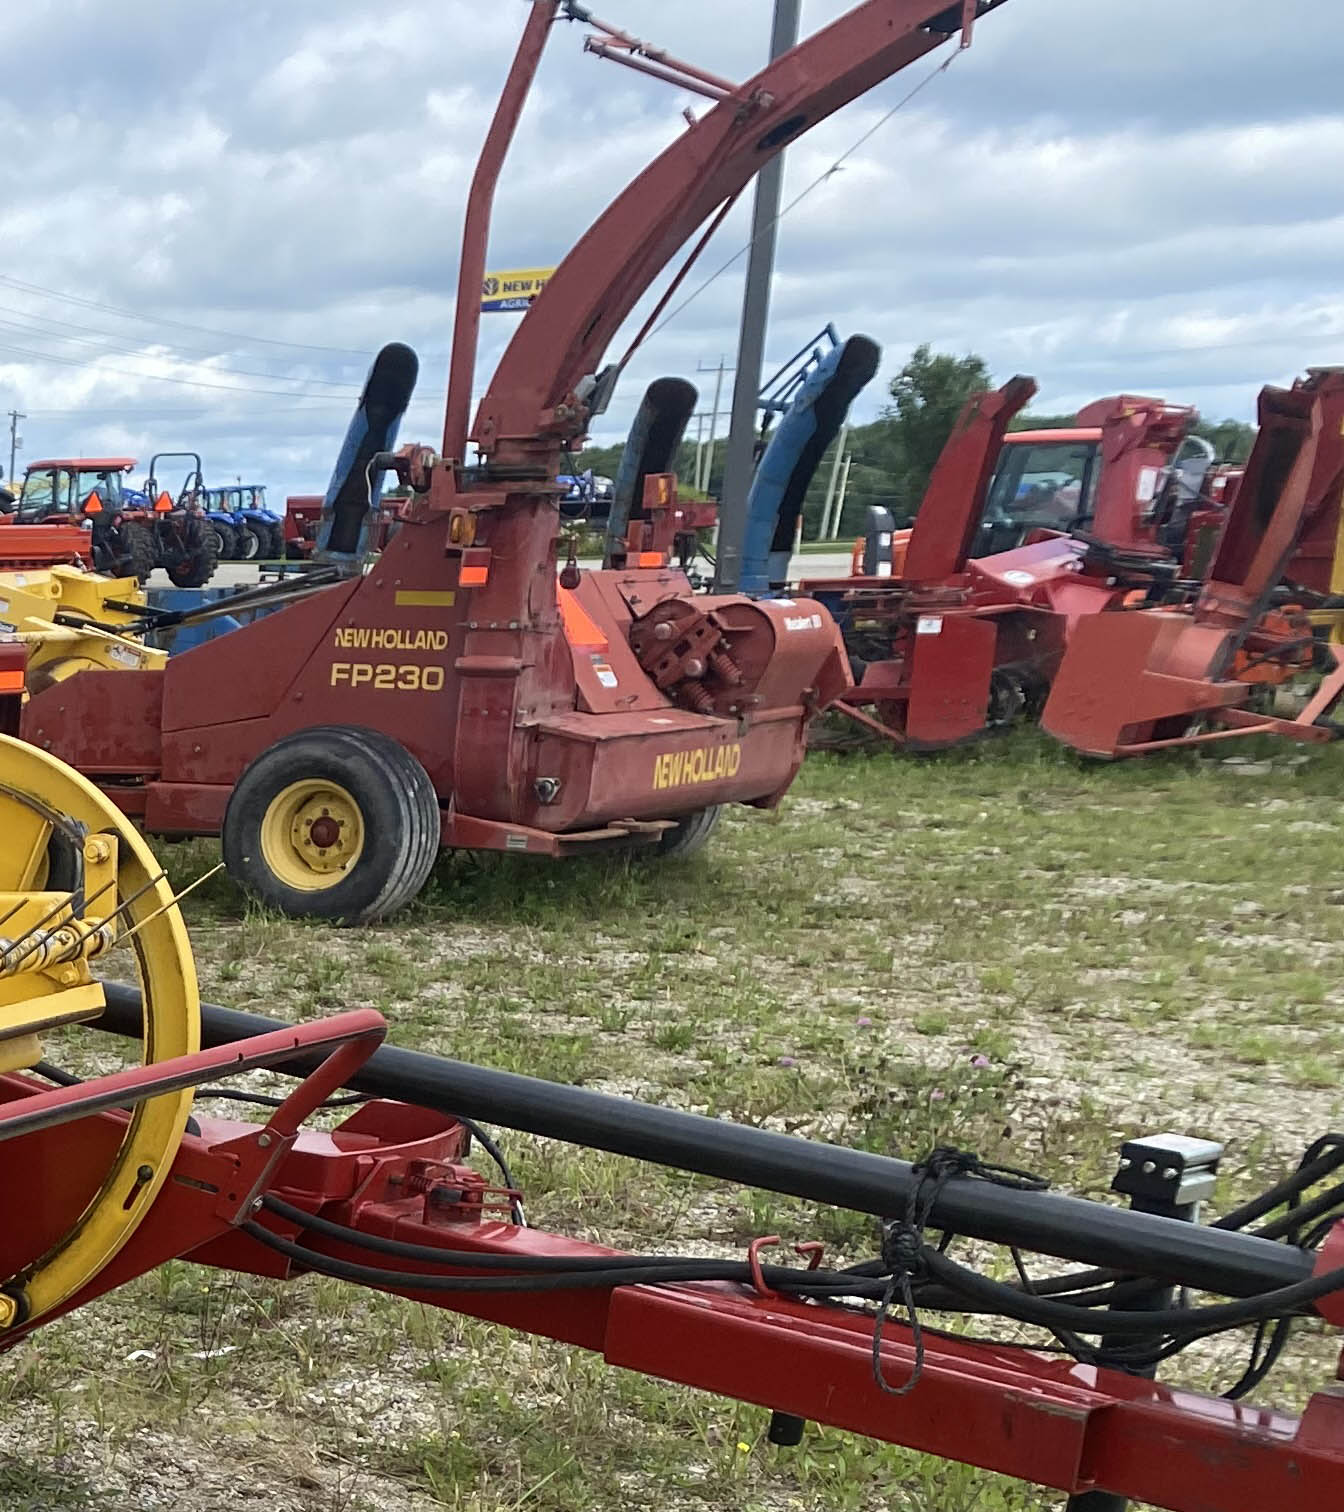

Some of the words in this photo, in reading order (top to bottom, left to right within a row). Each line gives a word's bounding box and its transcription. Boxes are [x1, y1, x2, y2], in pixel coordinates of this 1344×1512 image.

[503, 279, 533, 293] NEW
[335, 627, 370, 648] NEW
[371, 629, 448, 650] HOLLAND
[330, 662, 445, 691] FP230
[653, 751, 683, 790] NEW
[681, 743, 741, 784] HOLLAND
